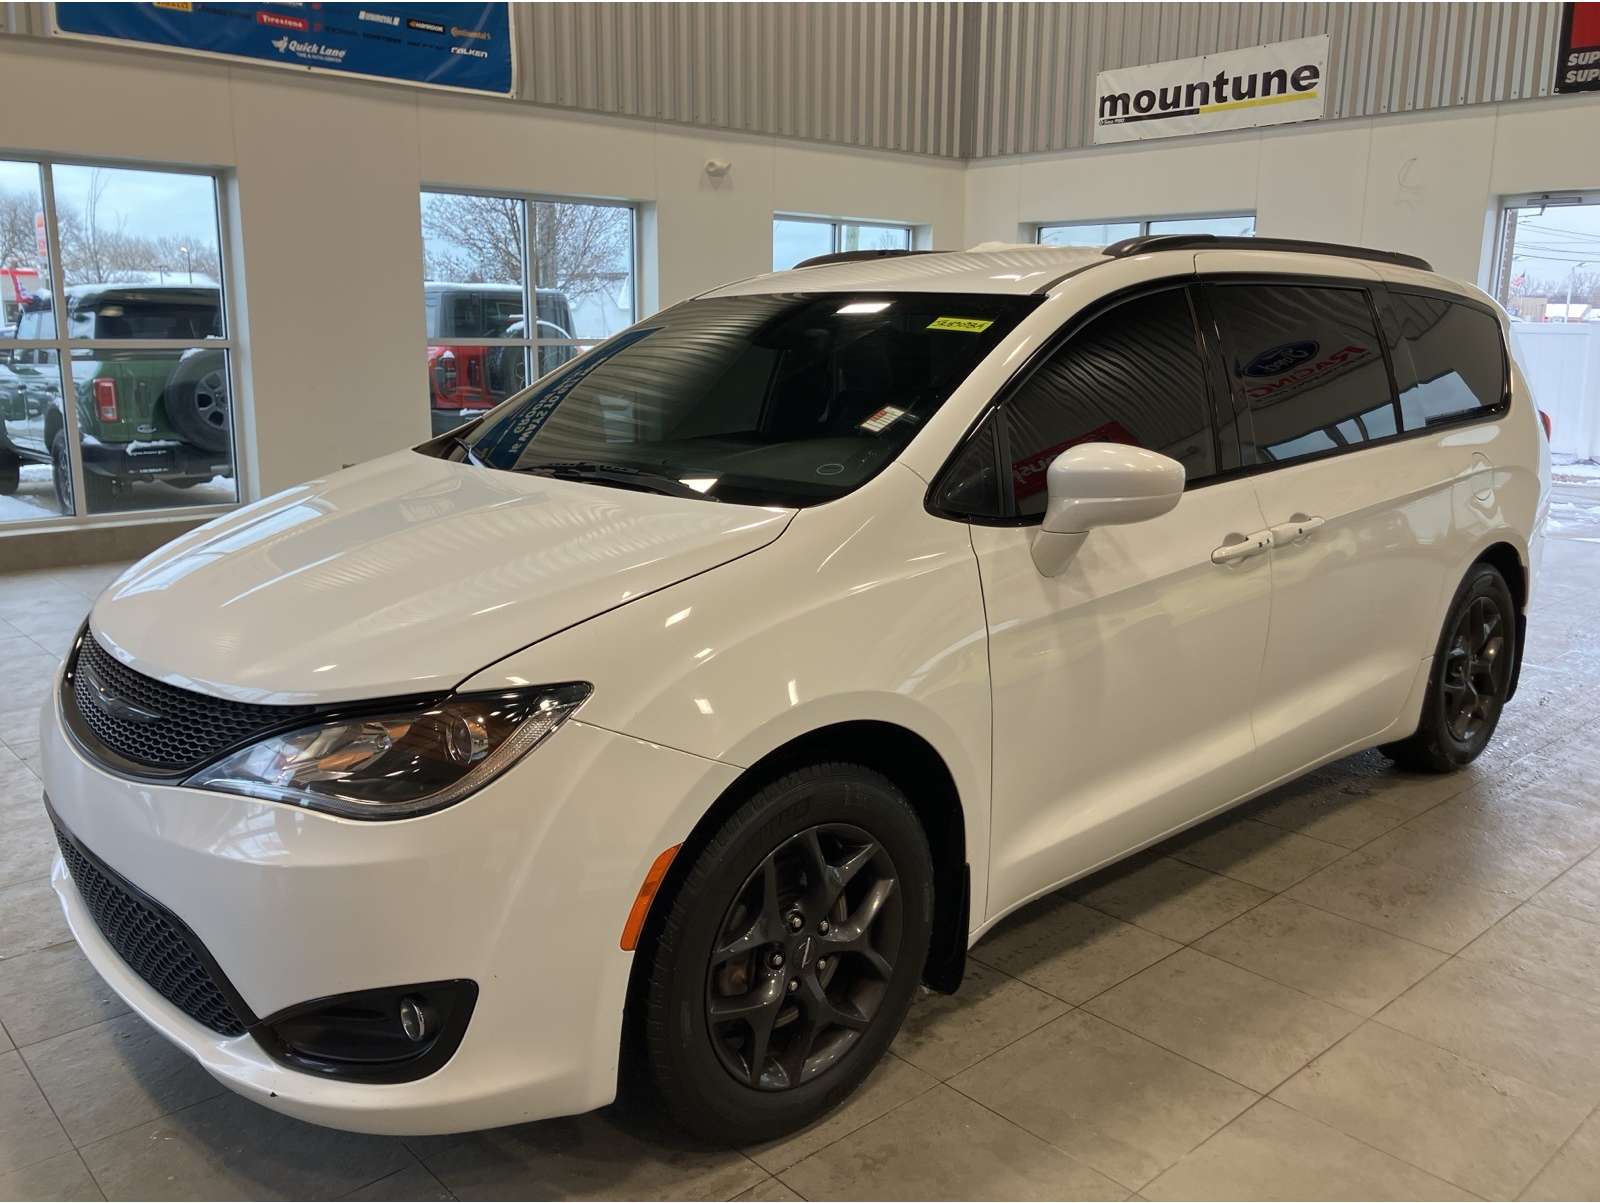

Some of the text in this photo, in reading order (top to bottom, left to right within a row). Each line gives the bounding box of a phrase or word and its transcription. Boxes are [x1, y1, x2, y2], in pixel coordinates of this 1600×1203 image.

[263, 14, 303, 28] Firestone
[289, 40, 320, 54] Quick
[320, 45, 347, 58] Lane
[451, 46, 488, 58] FALKEN
[1565, 69, 1600, 83] SUP
[1099, 64, 1320, 118] mountune
